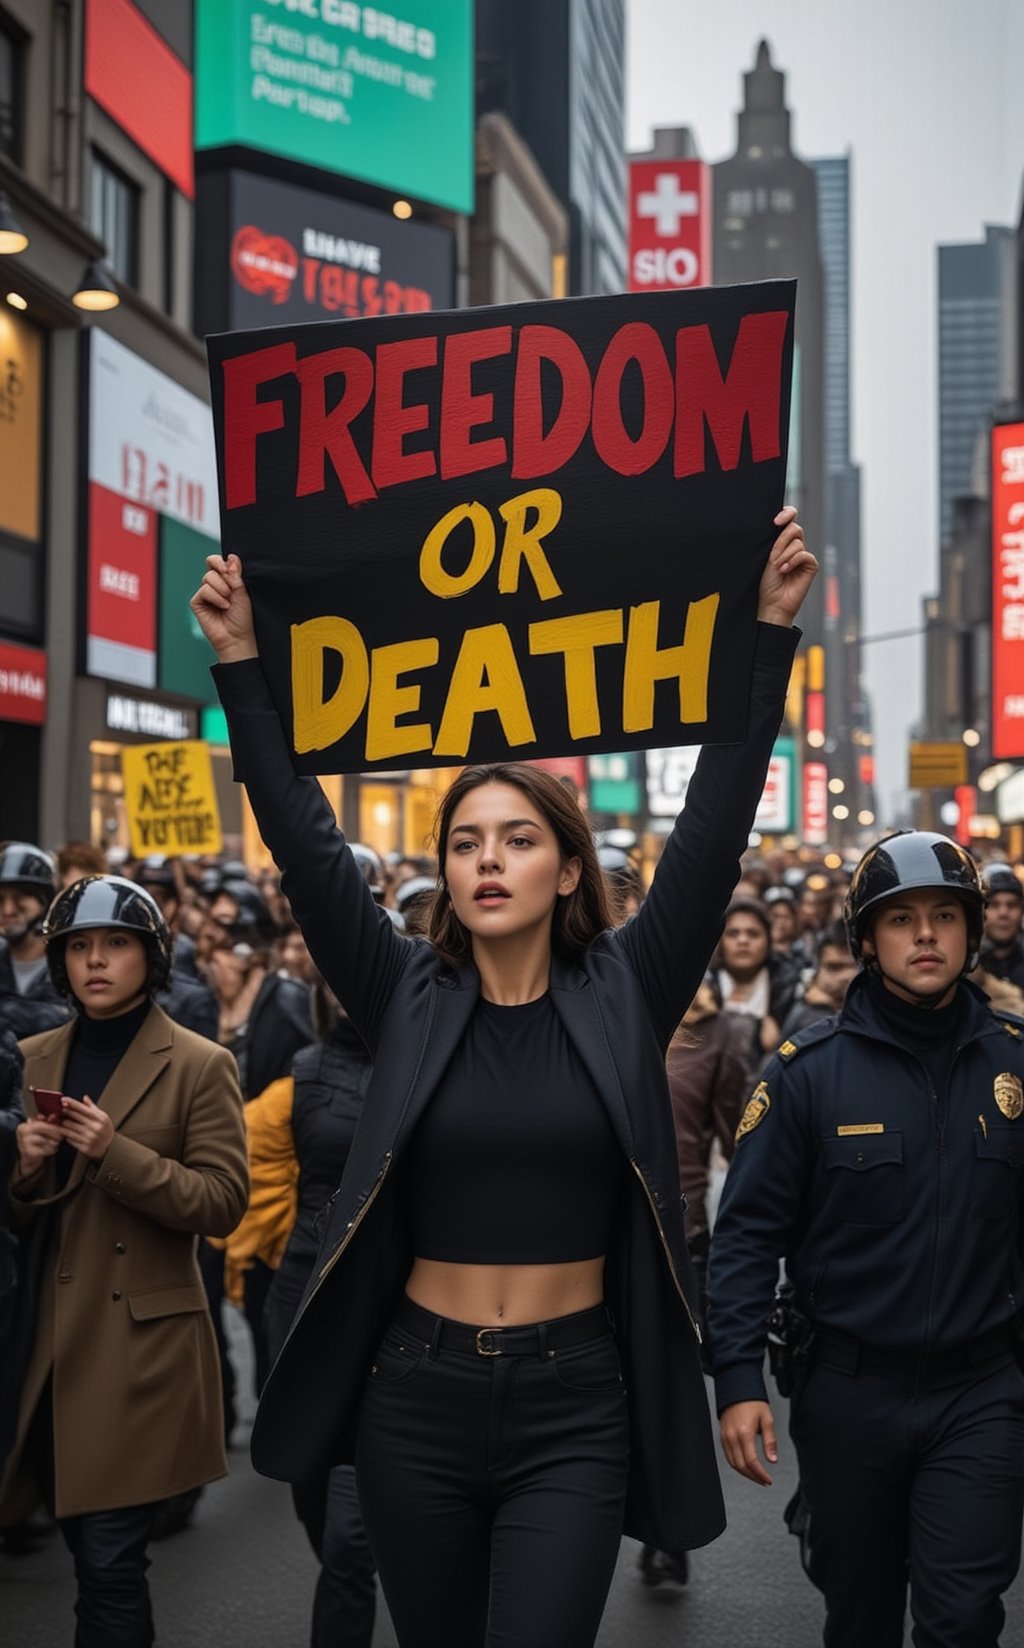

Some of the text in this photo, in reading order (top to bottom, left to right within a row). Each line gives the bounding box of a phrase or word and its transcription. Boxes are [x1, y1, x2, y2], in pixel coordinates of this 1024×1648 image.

[633, 247, 698, 285] SIO
[221, 310, 789, 510] FREEDOM
[419, 488, 563, 600] OR
[290, 592, 720, 761] DEATH
